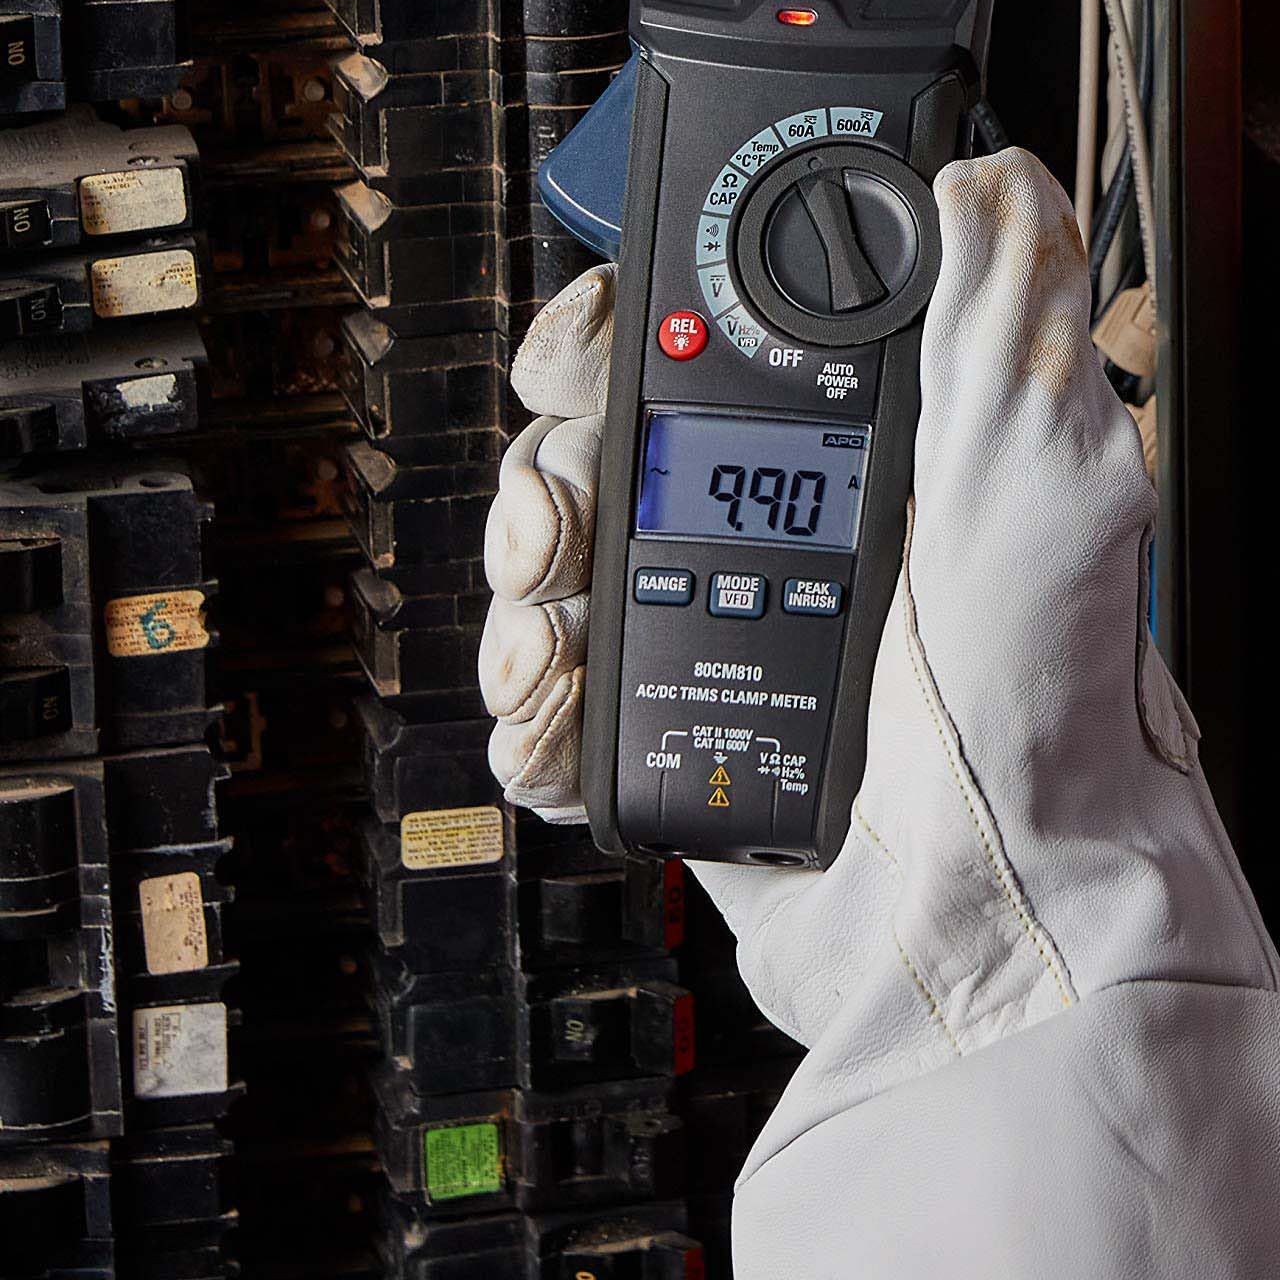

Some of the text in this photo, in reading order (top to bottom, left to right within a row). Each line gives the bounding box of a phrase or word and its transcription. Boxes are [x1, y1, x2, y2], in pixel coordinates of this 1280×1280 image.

[8, 40, 26, 66] ON
[788, 124, 815, 138] 60A
[836, 119, 872, 133] 600A
[751, 141, 779, 154] Temp
[709, 191, 738, 205] CAP
[13, 208, 31, 233] ON
[711, 282, 723, 298] V
[30, 294, 48, 321] ON
[670, 319, 697, 334] REL
[727, 321, 738, 336] V
[740, 338, 756, 346] VFD
[768, 349, 803, 367] OFF
[822, 363, 854, 376] AUTO
[817, 375, 858, 389] POWER
[826, 387, 848, 400] OFF
[824, 435, 862, 448] APO
[708, 464, 860, 536] 9.90 A
[639, 575, 687, 592] RANGE
[717, 575, 760, 591] MODE
[797, 581, 830, 596] PEAK
[724, 593, 749, 606] VFD
[789, 592, 836, 609] INRUSH
[694, 662, 763, 682] 80CM810
[636, 684, 817, 710] AC/DC TRMS CLAMP METER
[692, 725, 753, 741] CAT II 1000V
[694, 738, 749, 752] CAT III 600V
[646, 752, 681, 769] COM
[760, 752, 768, 764] V
[783, 754, 806, 767] CAP
[782, 768, 805, 780] Hz%
[780, 779, 808, 795] Temp
[565, 1018, 585, 1042] ON
